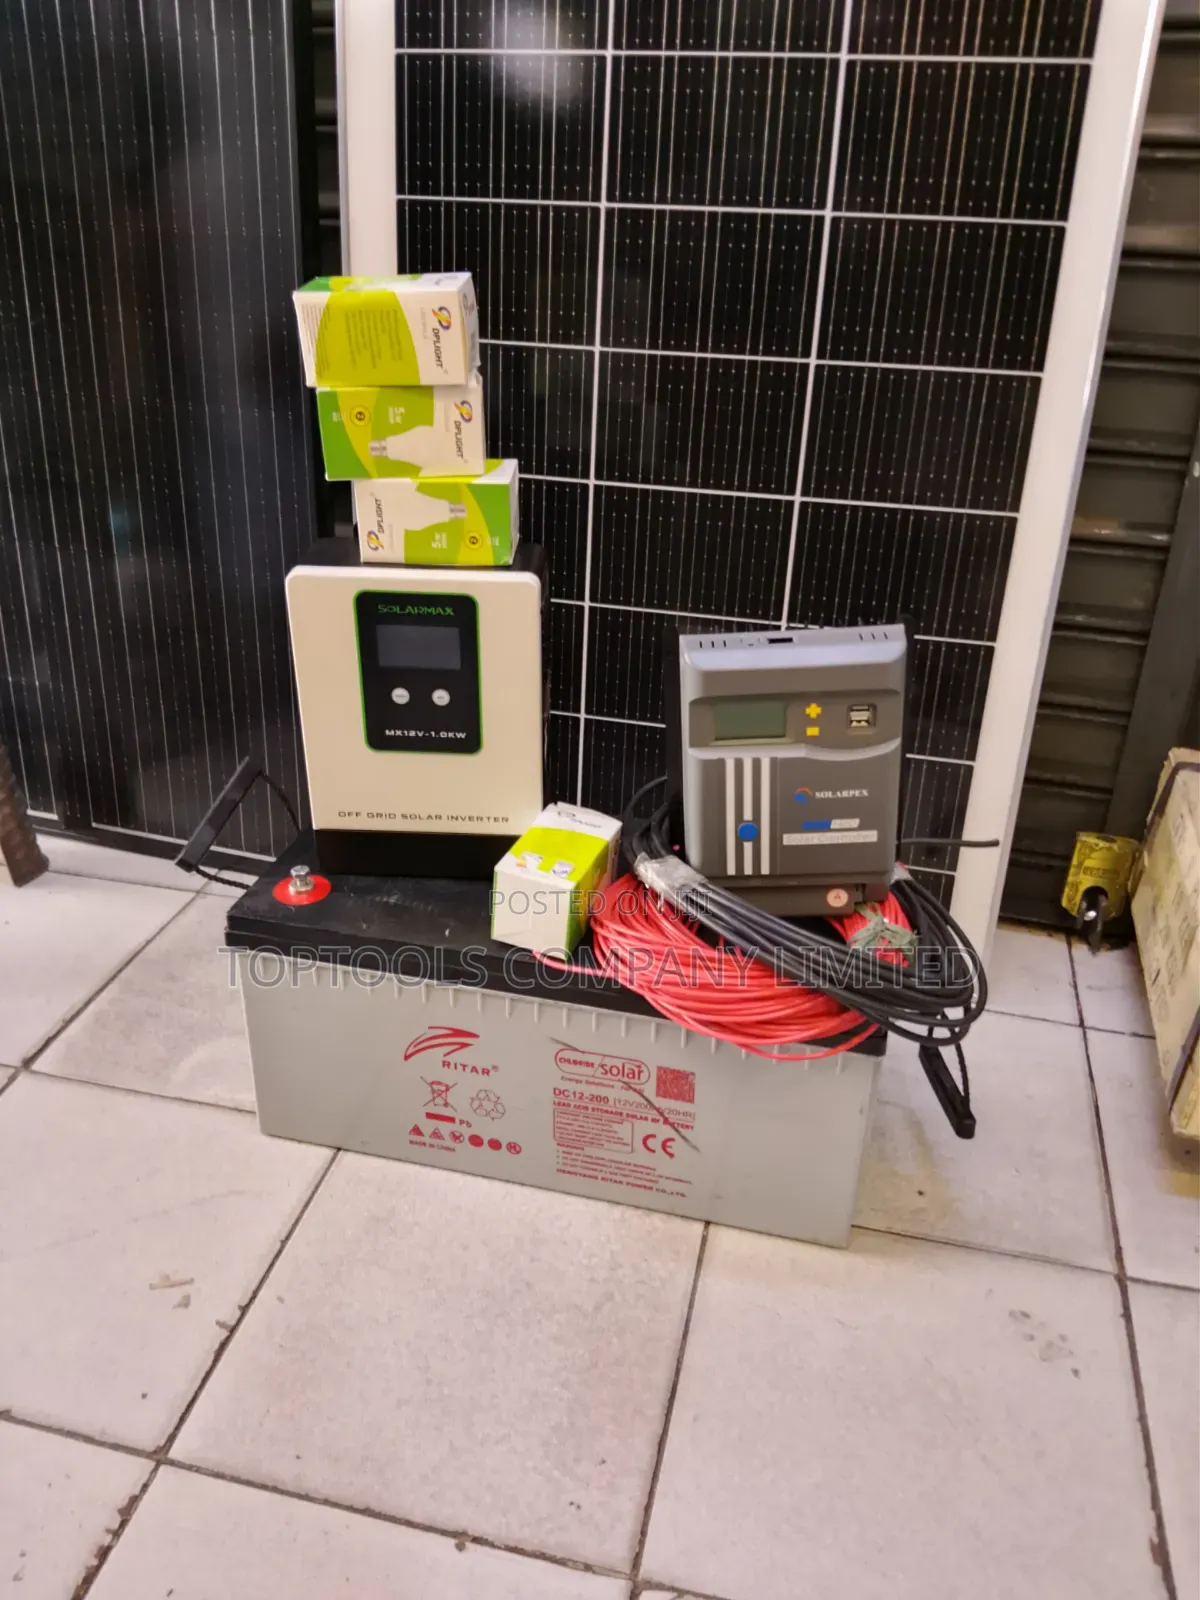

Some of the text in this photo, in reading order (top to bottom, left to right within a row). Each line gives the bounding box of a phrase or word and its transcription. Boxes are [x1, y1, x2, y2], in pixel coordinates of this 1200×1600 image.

[432, 328, 443, 369] DPLIGHT
[454, 420, 464, 459] DPLIGHT
[374, 497, 384, 534] DPLIGHT
[378, 604, 455, 616] SOLARMAX
[385, 729, 467, 739] MX12V-1.0KW
[815, 789, 869, 799] SOLARPEX
[338, 811, 509, 823] OFF GRID SOLAR INVERTER
[441, 1060, 491, 1077] RITAR
[600, 1062, 645, 1081] solar
[553, 1100, 571, 1109] LEAD
[662, 1119, 694, 1131] BTTERY
